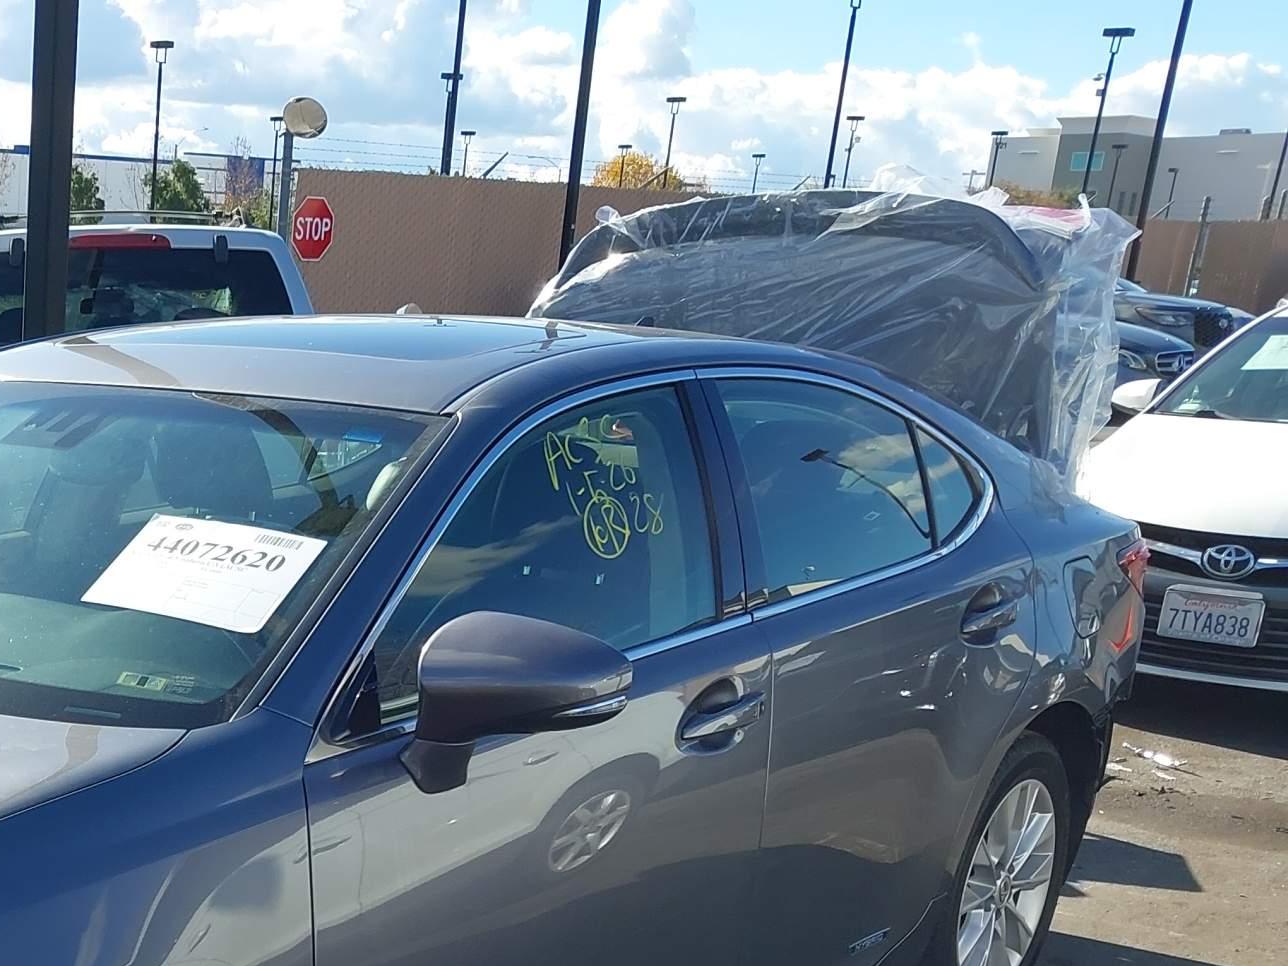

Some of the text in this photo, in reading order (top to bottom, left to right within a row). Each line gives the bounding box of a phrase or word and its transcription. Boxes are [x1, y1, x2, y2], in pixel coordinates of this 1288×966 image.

[295, 217, 331, 240] STOP
[148, 536, 286, 572] 44072620
[1168, 608, 1250, 637] 7TYA838
